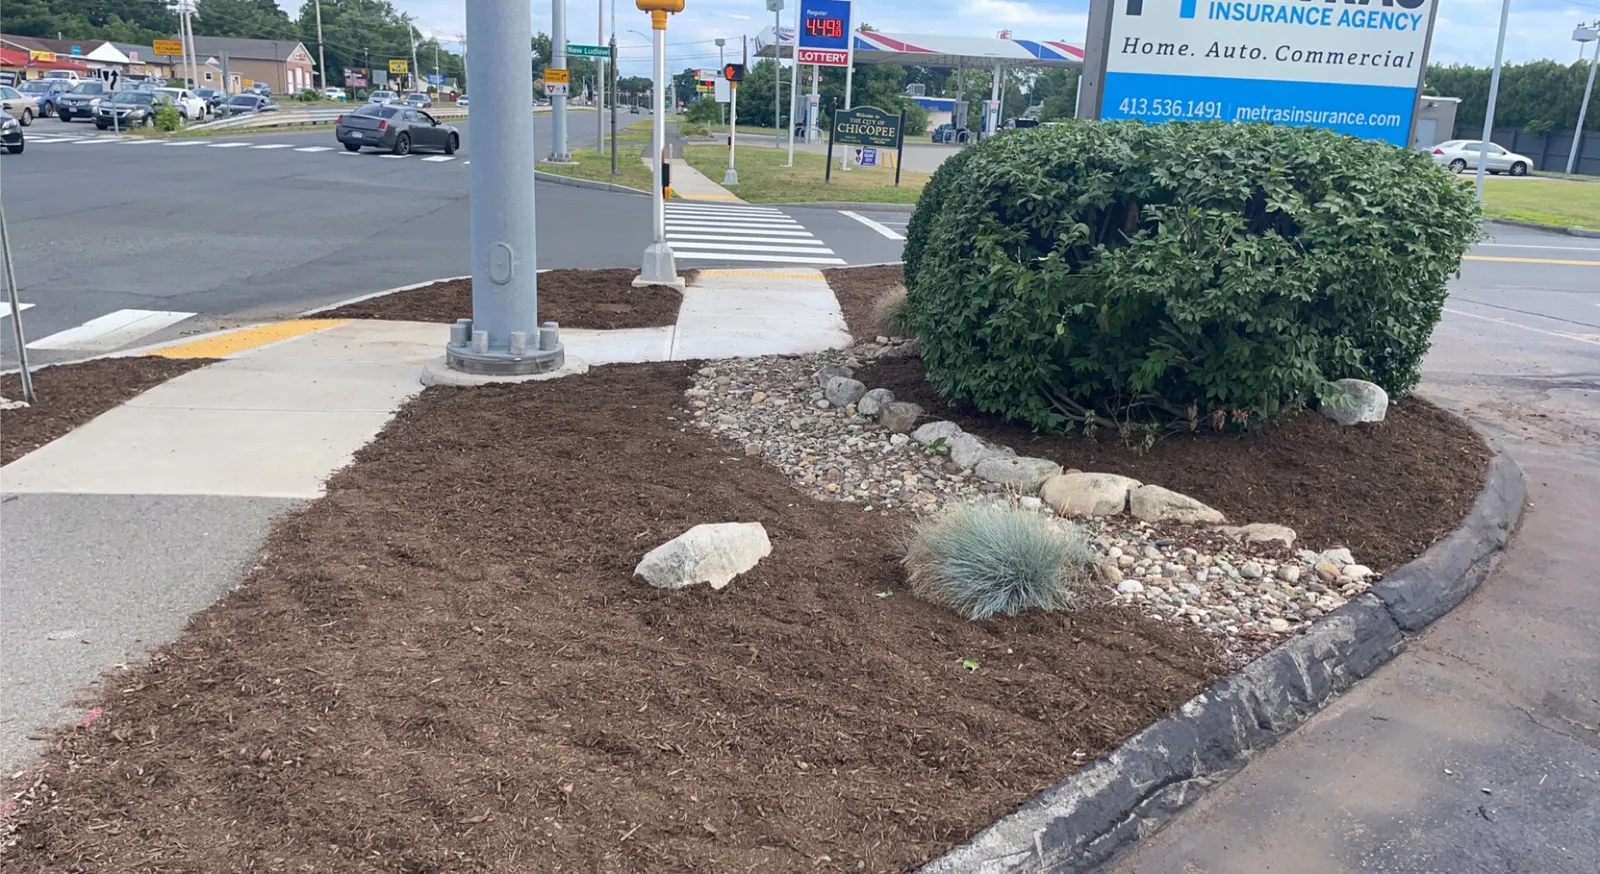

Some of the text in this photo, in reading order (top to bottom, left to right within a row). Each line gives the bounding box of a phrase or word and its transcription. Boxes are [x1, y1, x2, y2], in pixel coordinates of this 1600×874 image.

[1208, 1, 1423, 31] INSURANCE AGENCY
[800, 52, 847, 62] LOTTERY
[1121, 37, 1415, 68] Home. Auto. Commercial
[1119, 97, 1401, 127] 413.536.1491 metrasinsurance.com
[837, 122, 896, 137] CHICOPEE
